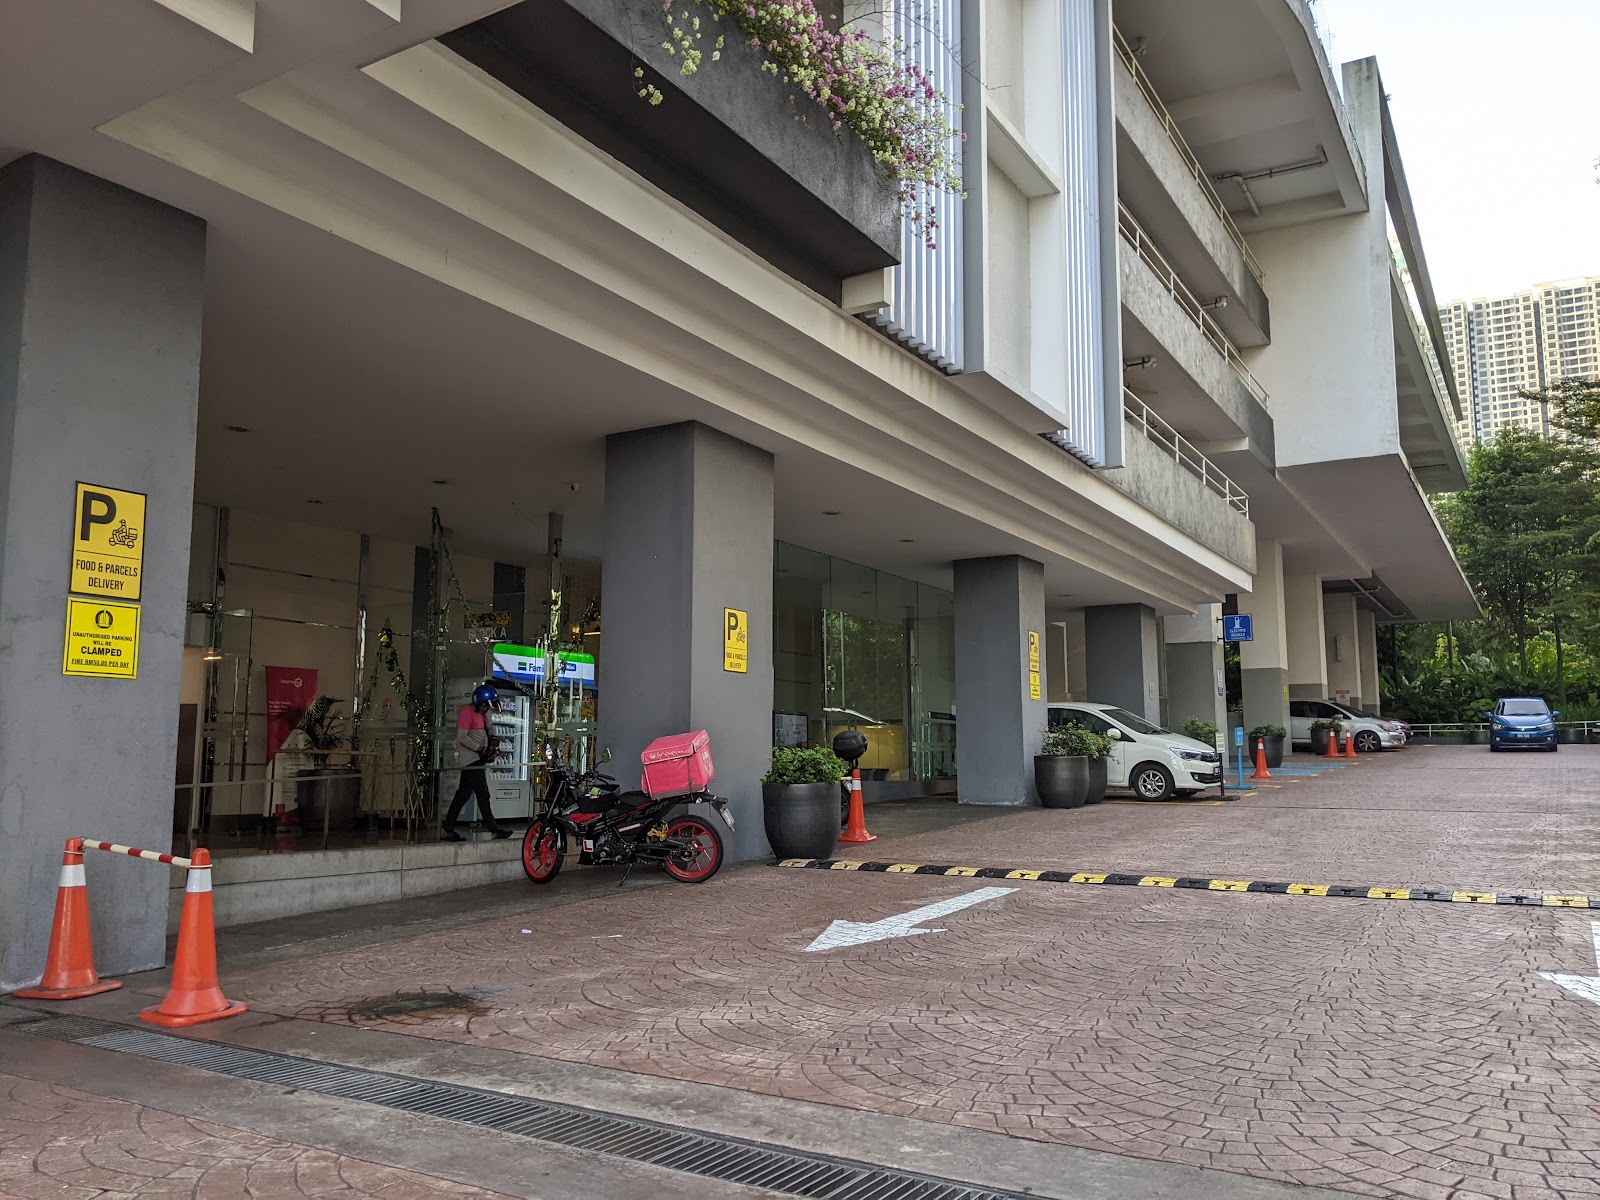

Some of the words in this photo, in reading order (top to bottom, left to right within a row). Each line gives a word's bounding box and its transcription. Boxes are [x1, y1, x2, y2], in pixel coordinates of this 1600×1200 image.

[80, 490, 117, 542] P
[75, 559, 96, 571] FOOD
[97, 562, 103, 573] &
[105, 563, 138, 577] PARCELS
[88, 576, 124, 590] DELIVERY
[728, 612, 738, 640] P
[72, 632, 110, 640] UNAUTHORISED
[468, 627, 497, 640] BOCK
[500, 627, 507, 637] A
[81, 646, 122, 657] CLAMPED
[583, 840, 593, 851] L
